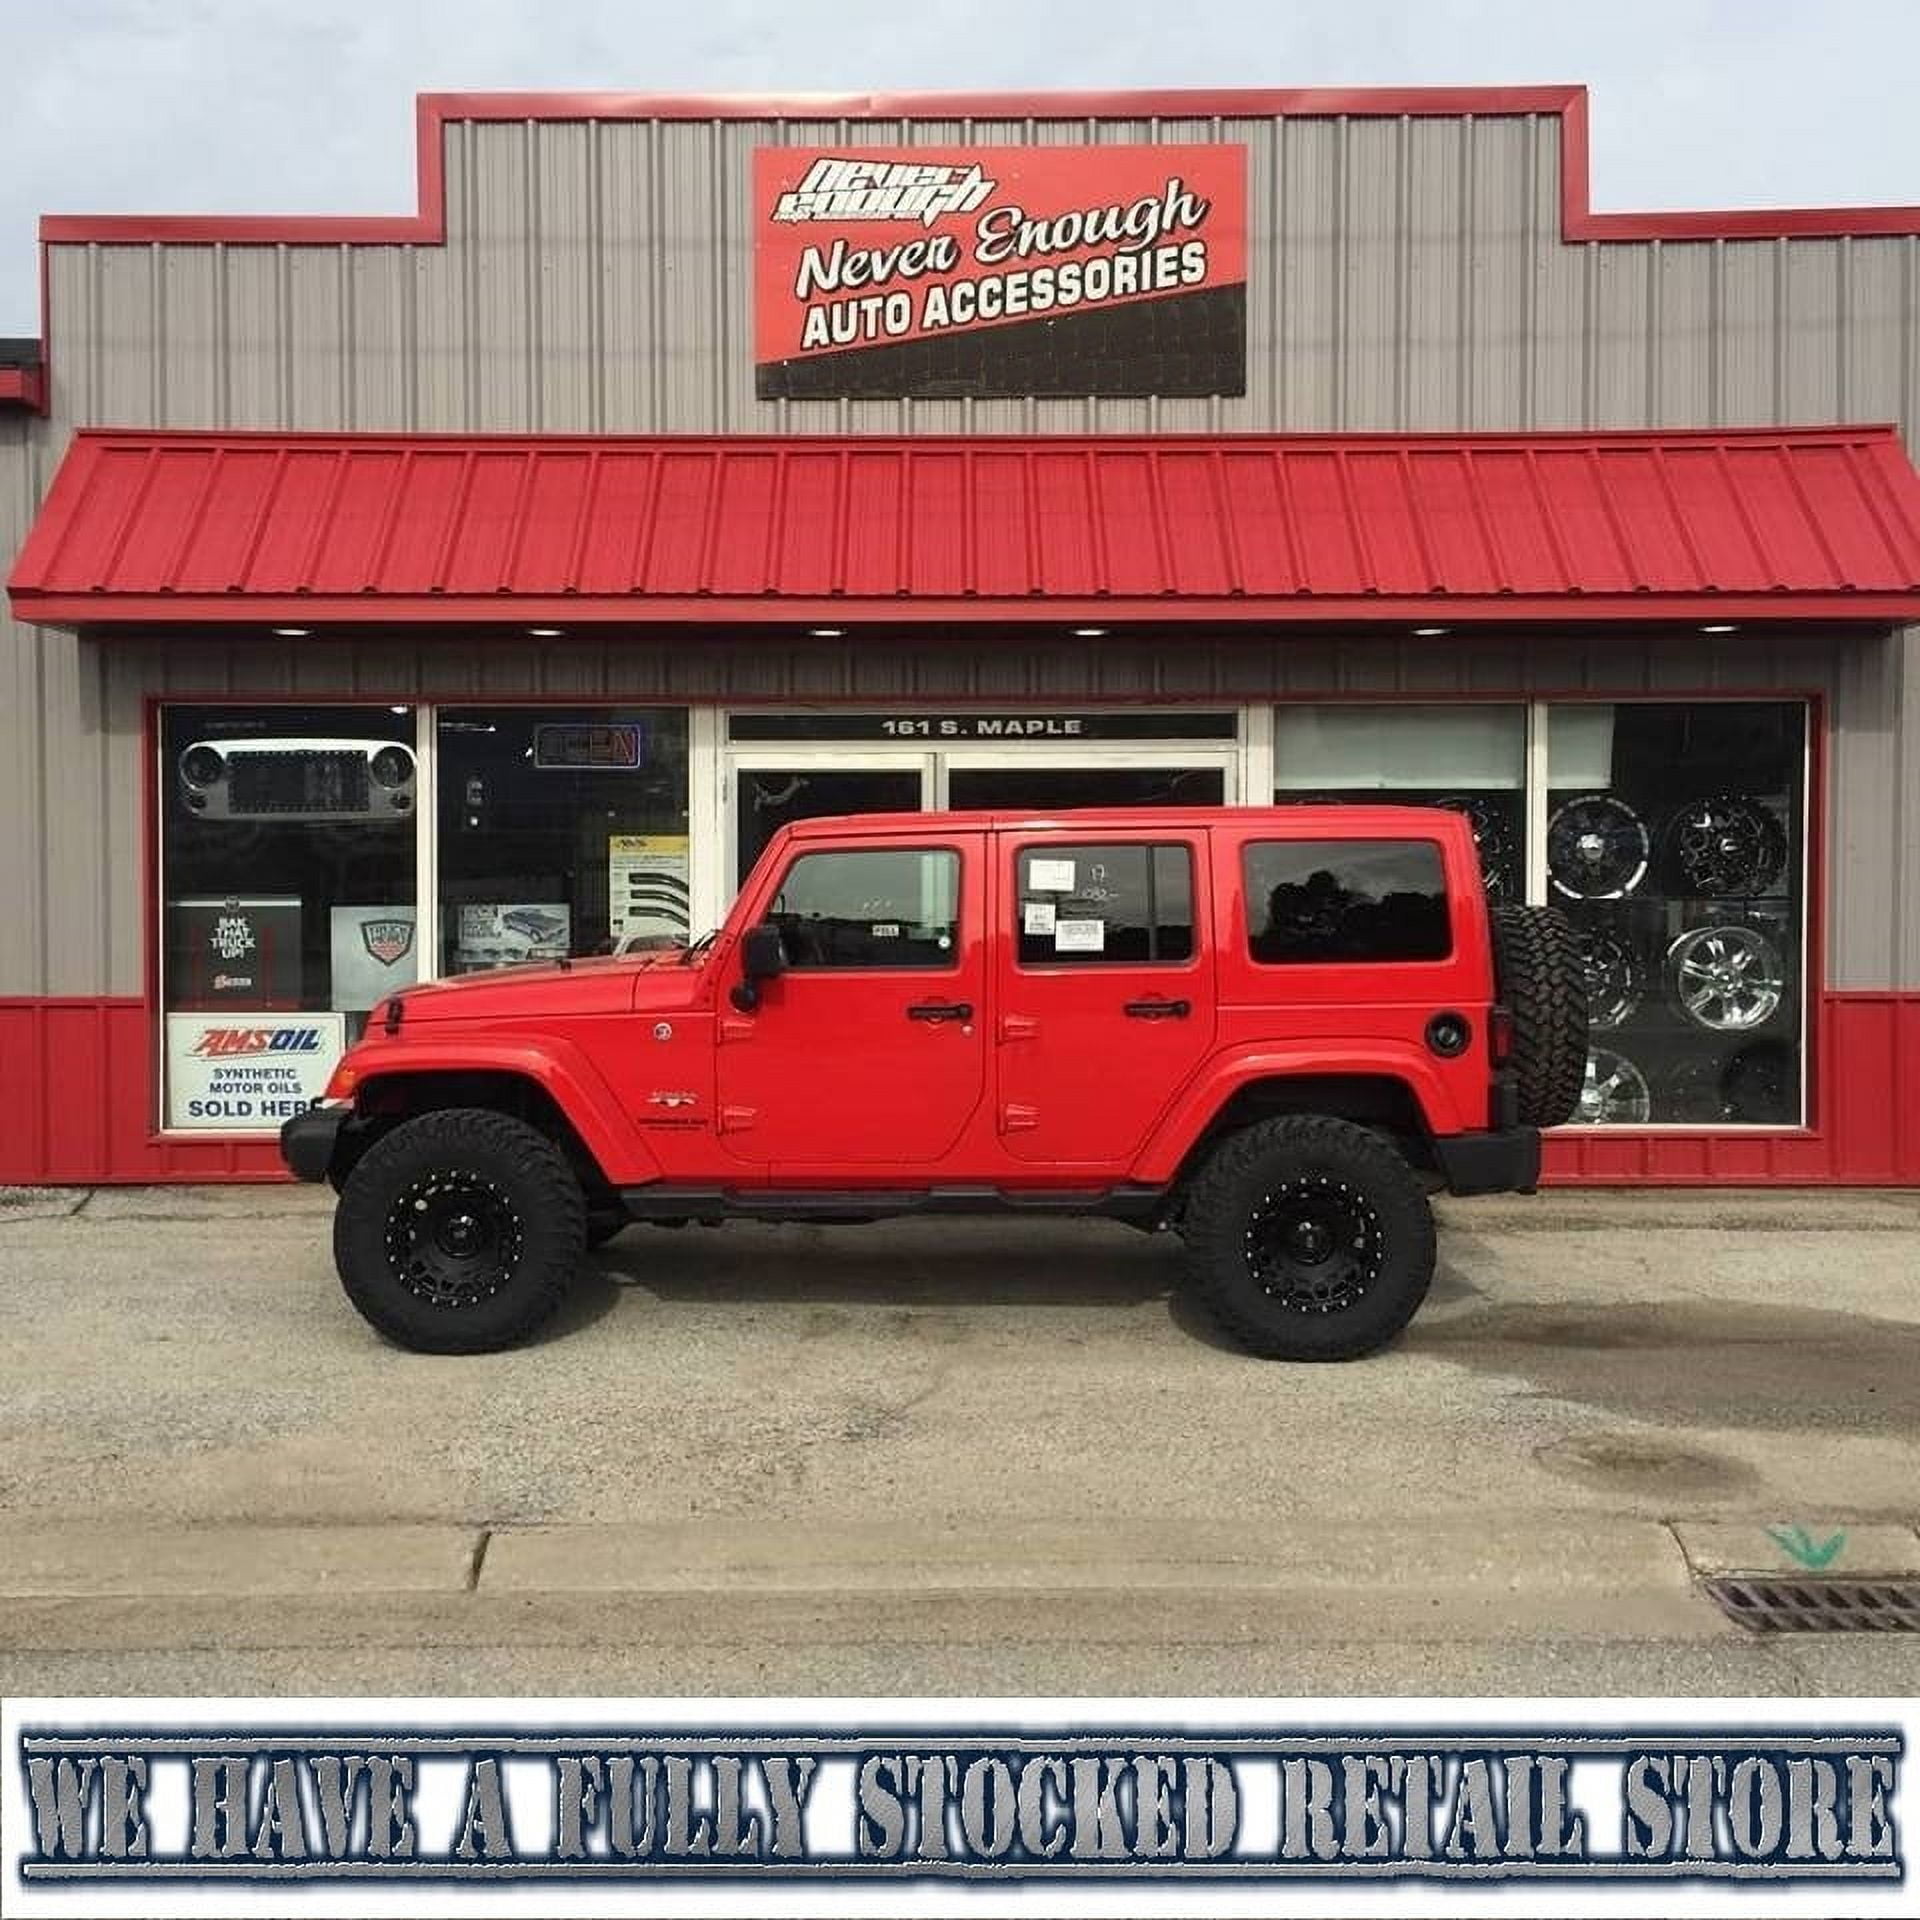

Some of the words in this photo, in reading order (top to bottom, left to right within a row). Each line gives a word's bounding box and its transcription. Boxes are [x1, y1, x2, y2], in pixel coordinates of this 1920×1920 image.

[796, 234, 956, 298] Never
[975, 178, 1208, 262] Enough
[802, 291, 910, 348] AUTO
[922, 243, 1206, 329] ACCESSORIES
[881, 720, 929, 735] 161
[940, 720, 968, 735] S.
[977, 719, 1082, 735] MAPLE
[194, 1029, 320, 1056] AMSOIL
[213, 1068, 296, 1080] SYNTHETIC
[209, 1082, 263, 1094] MOTOR
[267, 1082, 303, 1095] OILS
[188, 1101, 253, 1117] SOLD
